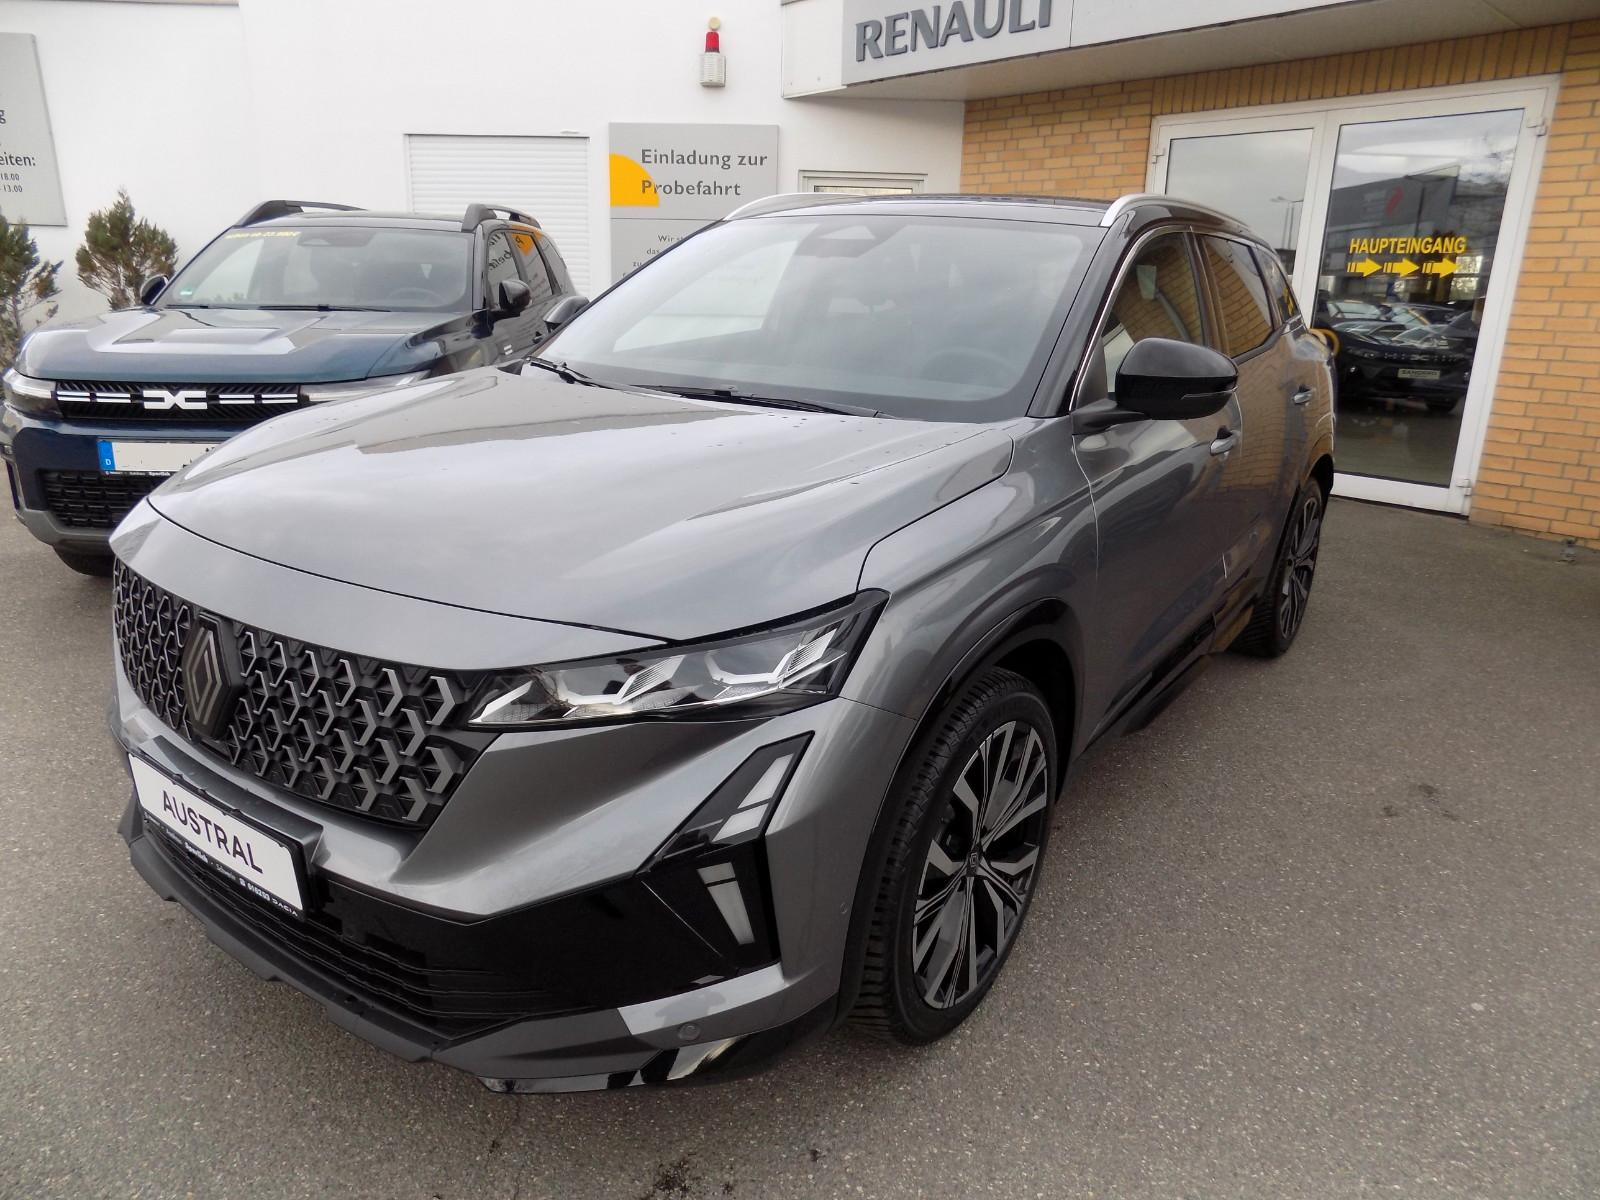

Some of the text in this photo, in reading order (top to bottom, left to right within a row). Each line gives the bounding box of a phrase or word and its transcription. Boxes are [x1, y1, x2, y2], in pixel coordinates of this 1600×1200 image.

[641, 149, 768, 170] Einladung zur
[641, 180, 741, 196] Probefahrt
[658, 234, 674, 242] Wir
[1349, 236, 1467, 254] HAUPTEINGANG
[163, 790, 263, 874] AUSTRAL
